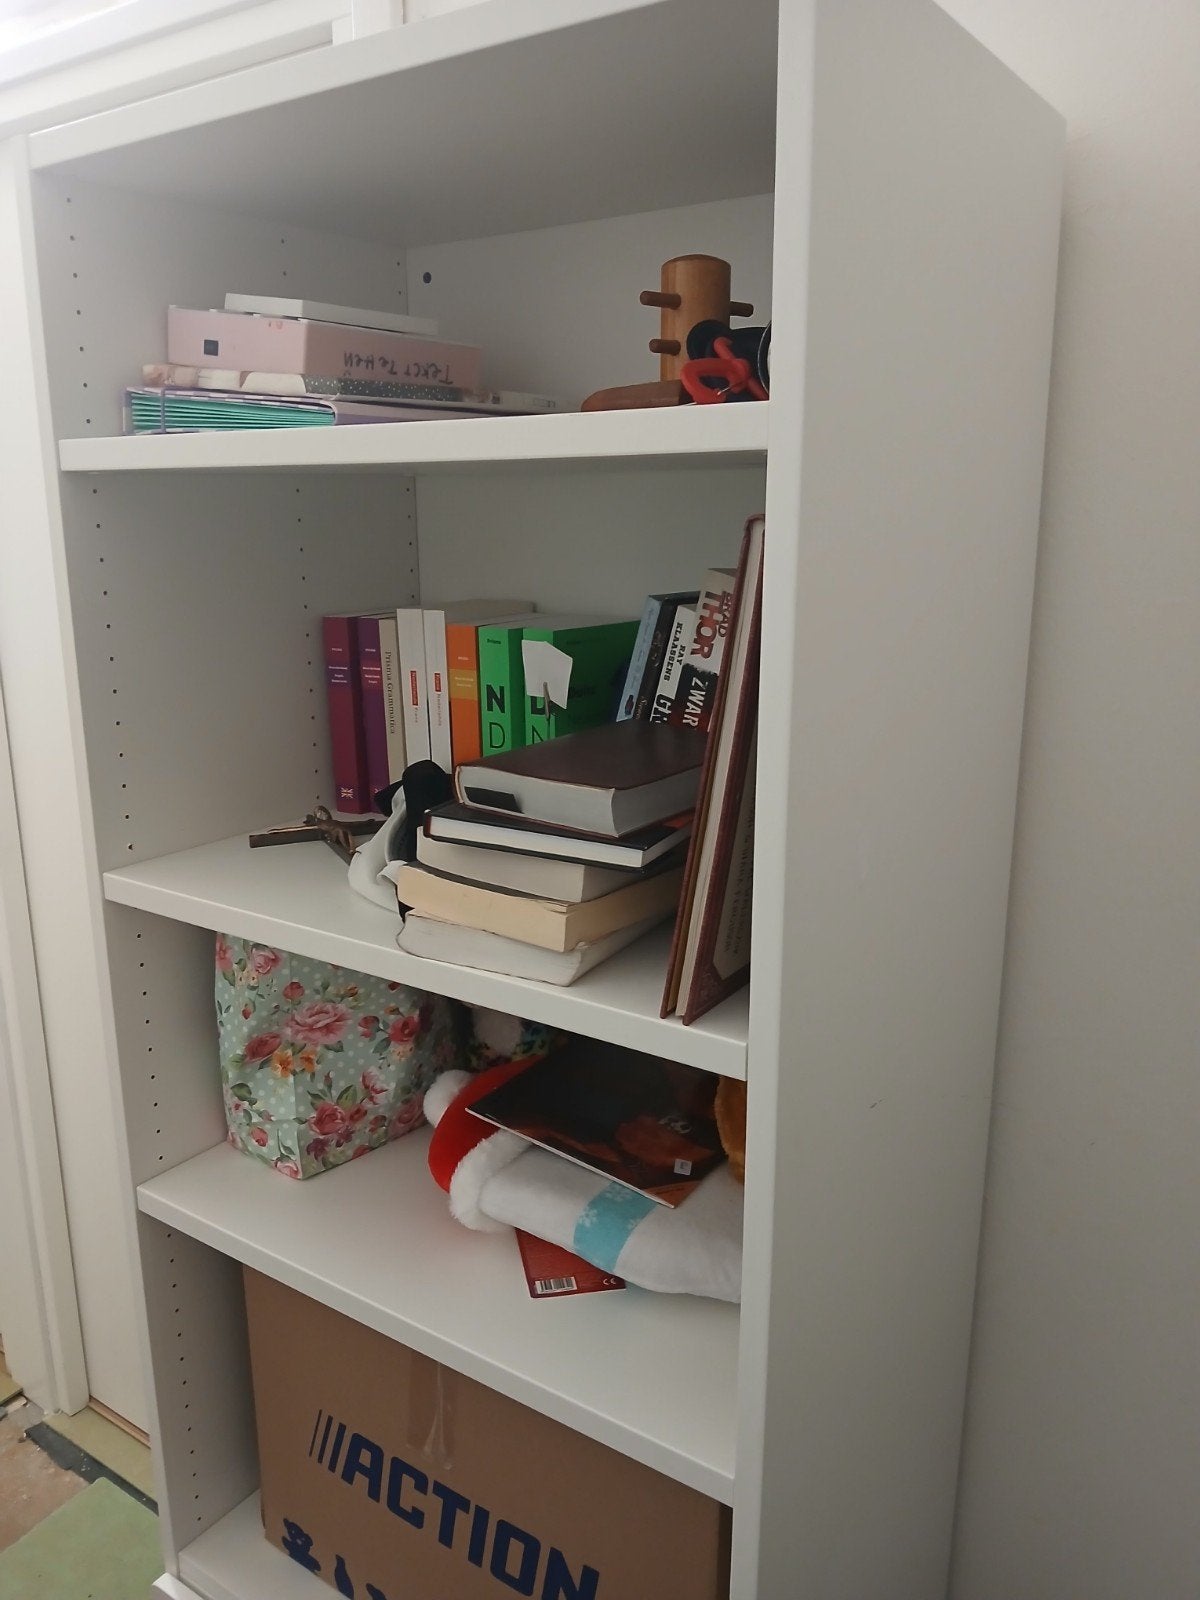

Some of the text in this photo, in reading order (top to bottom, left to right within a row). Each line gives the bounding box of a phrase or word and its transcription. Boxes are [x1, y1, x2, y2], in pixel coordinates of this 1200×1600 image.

[690, 591, 724, 659] THOR
[663, 622, 684, 682] KLAASSENS
[676, 645, 686, 666] RAY
[486, 684, 505, 714] N
[489, 721, 505, 749] D
[341, 1432, 600, 1600] ACTION
